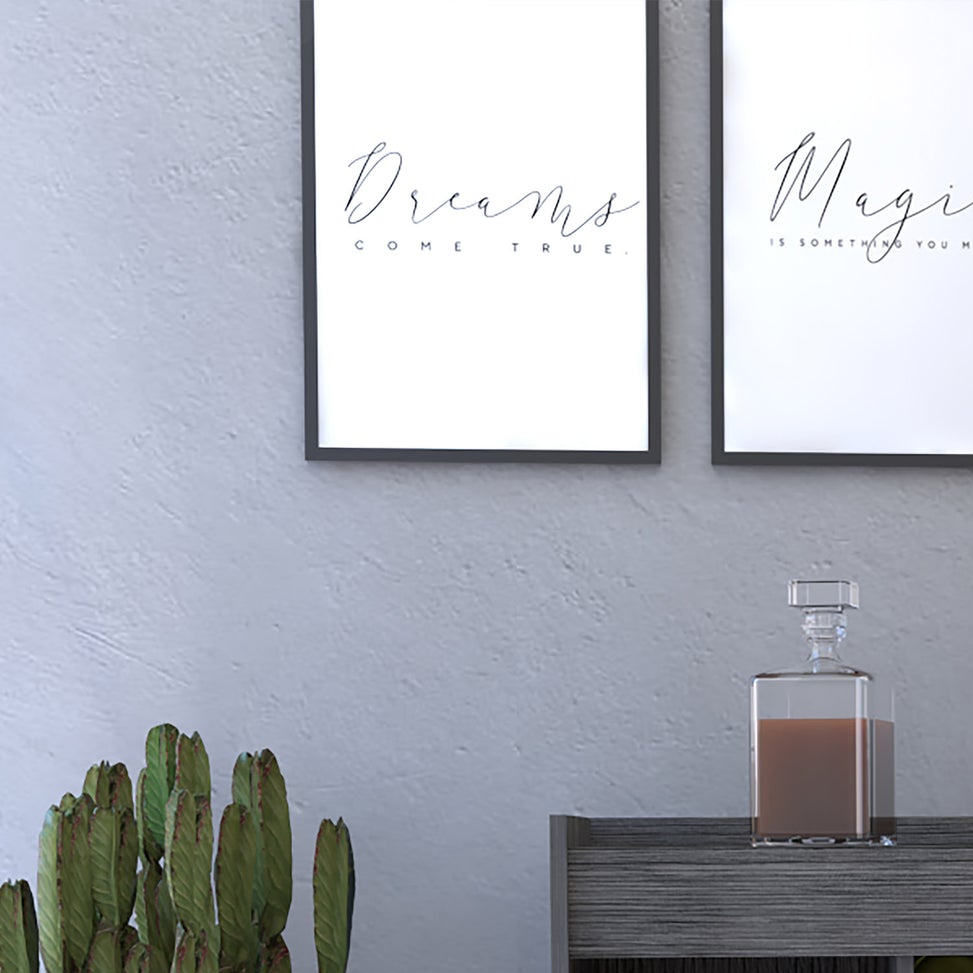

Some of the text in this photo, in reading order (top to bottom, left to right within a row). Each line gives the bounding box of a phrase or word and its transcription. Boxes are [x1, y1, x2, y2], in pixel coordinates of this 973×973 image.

[344, 141, 640, 237] Dreams
[354, 239, 629, 255] COME TRUE.
[770, 238, 785, 247] IS
[799, 238, 903, 249] SOMETHING
[916, 239, 948, 250] YOU
